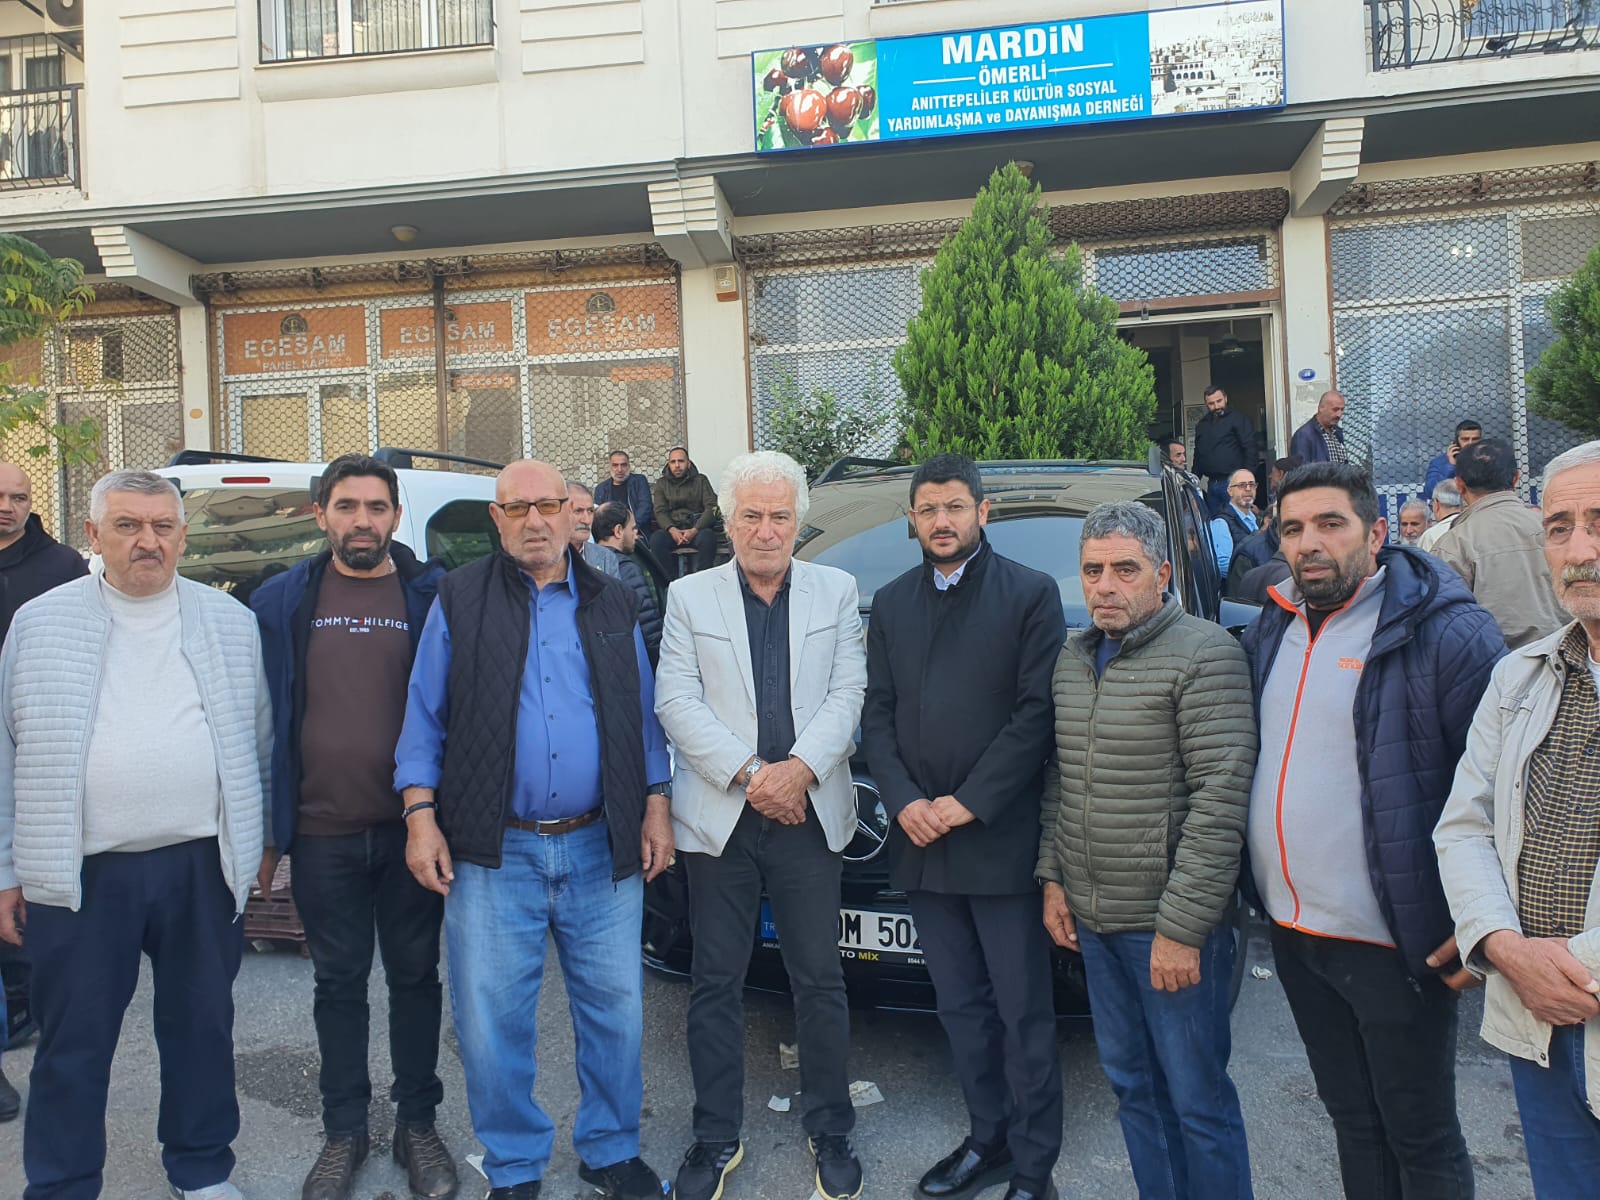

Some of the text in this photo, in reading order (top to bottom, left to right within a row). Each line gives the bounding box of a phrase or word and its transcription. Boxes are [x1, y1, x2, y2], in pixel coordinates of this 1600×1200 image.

[978, 59, 1047, 86] ÖMERLİ
[911, 79, 1117, 111] ANITTEPELİLER KÜLTÜR SOSYAL
[887, 94, 1144, 132] YARDIMLAŞMA ve DAYANIŞMA DERNEĞİ
[400, 321, 496, 344] EGSAM
[547, 312, 656, 339] EGESAM
[244, 333, 346, 359] EGESAM
[364, 616, 409, 631] HILFIGE
[763, 921, 776, 932] TR
[839, 949, 856, 959] TO
